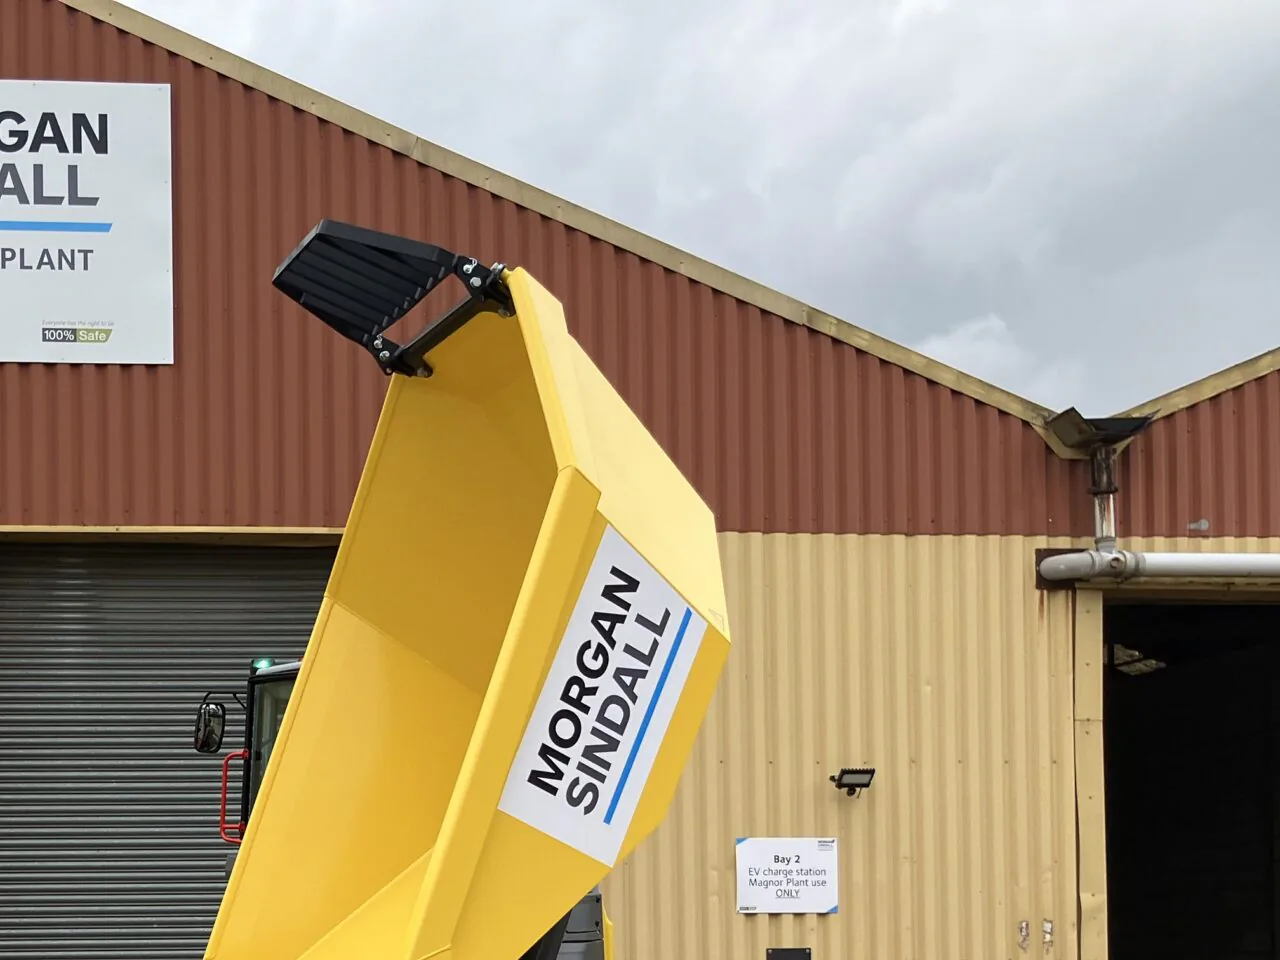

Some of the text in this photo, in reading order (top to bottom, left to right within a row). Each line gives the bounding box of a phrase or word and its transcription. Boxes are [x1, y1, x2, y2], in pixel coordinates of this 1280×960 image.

[1, 248, 94, 271] PLANT
[44, 329, 107, 341] 100% Safe
[527, 565, 641, 797] MORGAN
[565, 607, 671, 816] SINDALL
[773, 855, 801, 866] Bay 2
[748, 867, 827, 878] EV charge station
[748, 878, 827, 889] Magnor Plant use
[775, 889, 800, 898] ONLY
